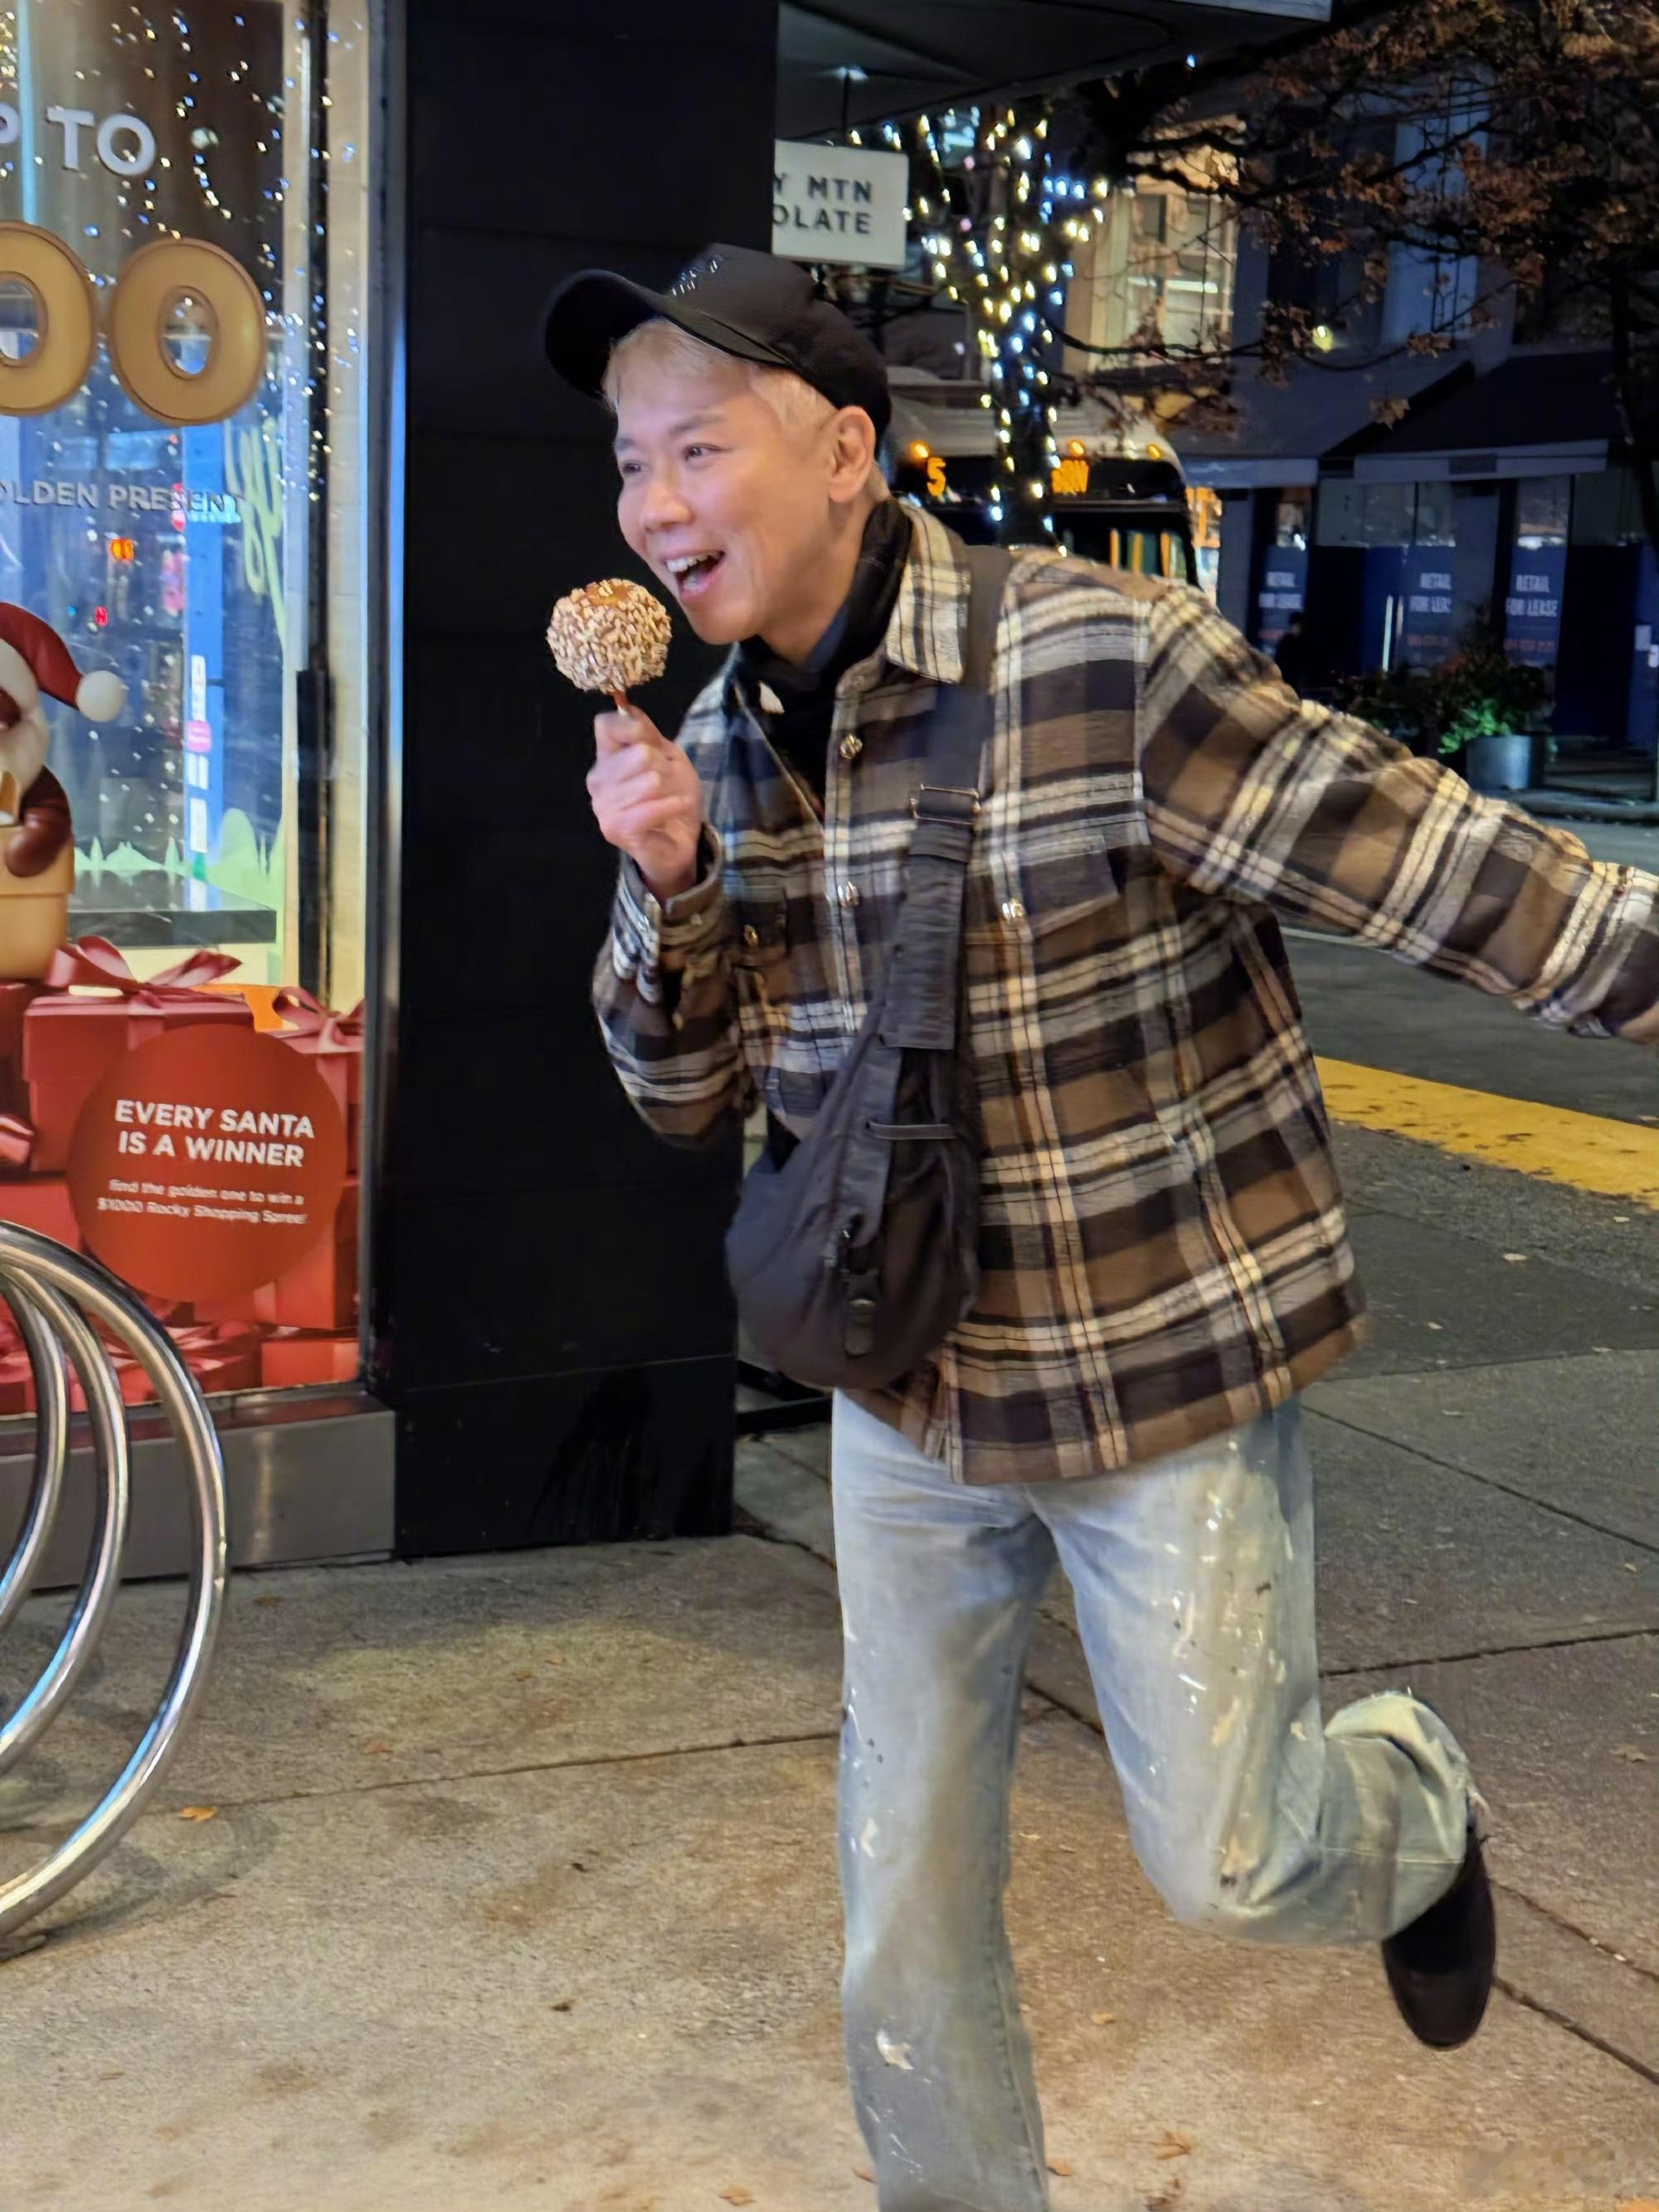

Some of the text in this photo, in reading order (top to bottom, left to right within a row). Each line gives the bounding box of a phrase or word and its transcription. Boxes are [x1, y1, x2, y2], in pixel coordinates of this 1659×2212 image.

[47, 106, 156, 176] TO
[808, 175, 872, 203] MTN
[772, 204, 871, 234] OLATE
[114, 1099, 315, 1139] EVERY SANTA
[118, 1130, 305, 1167] IS A WINNER
